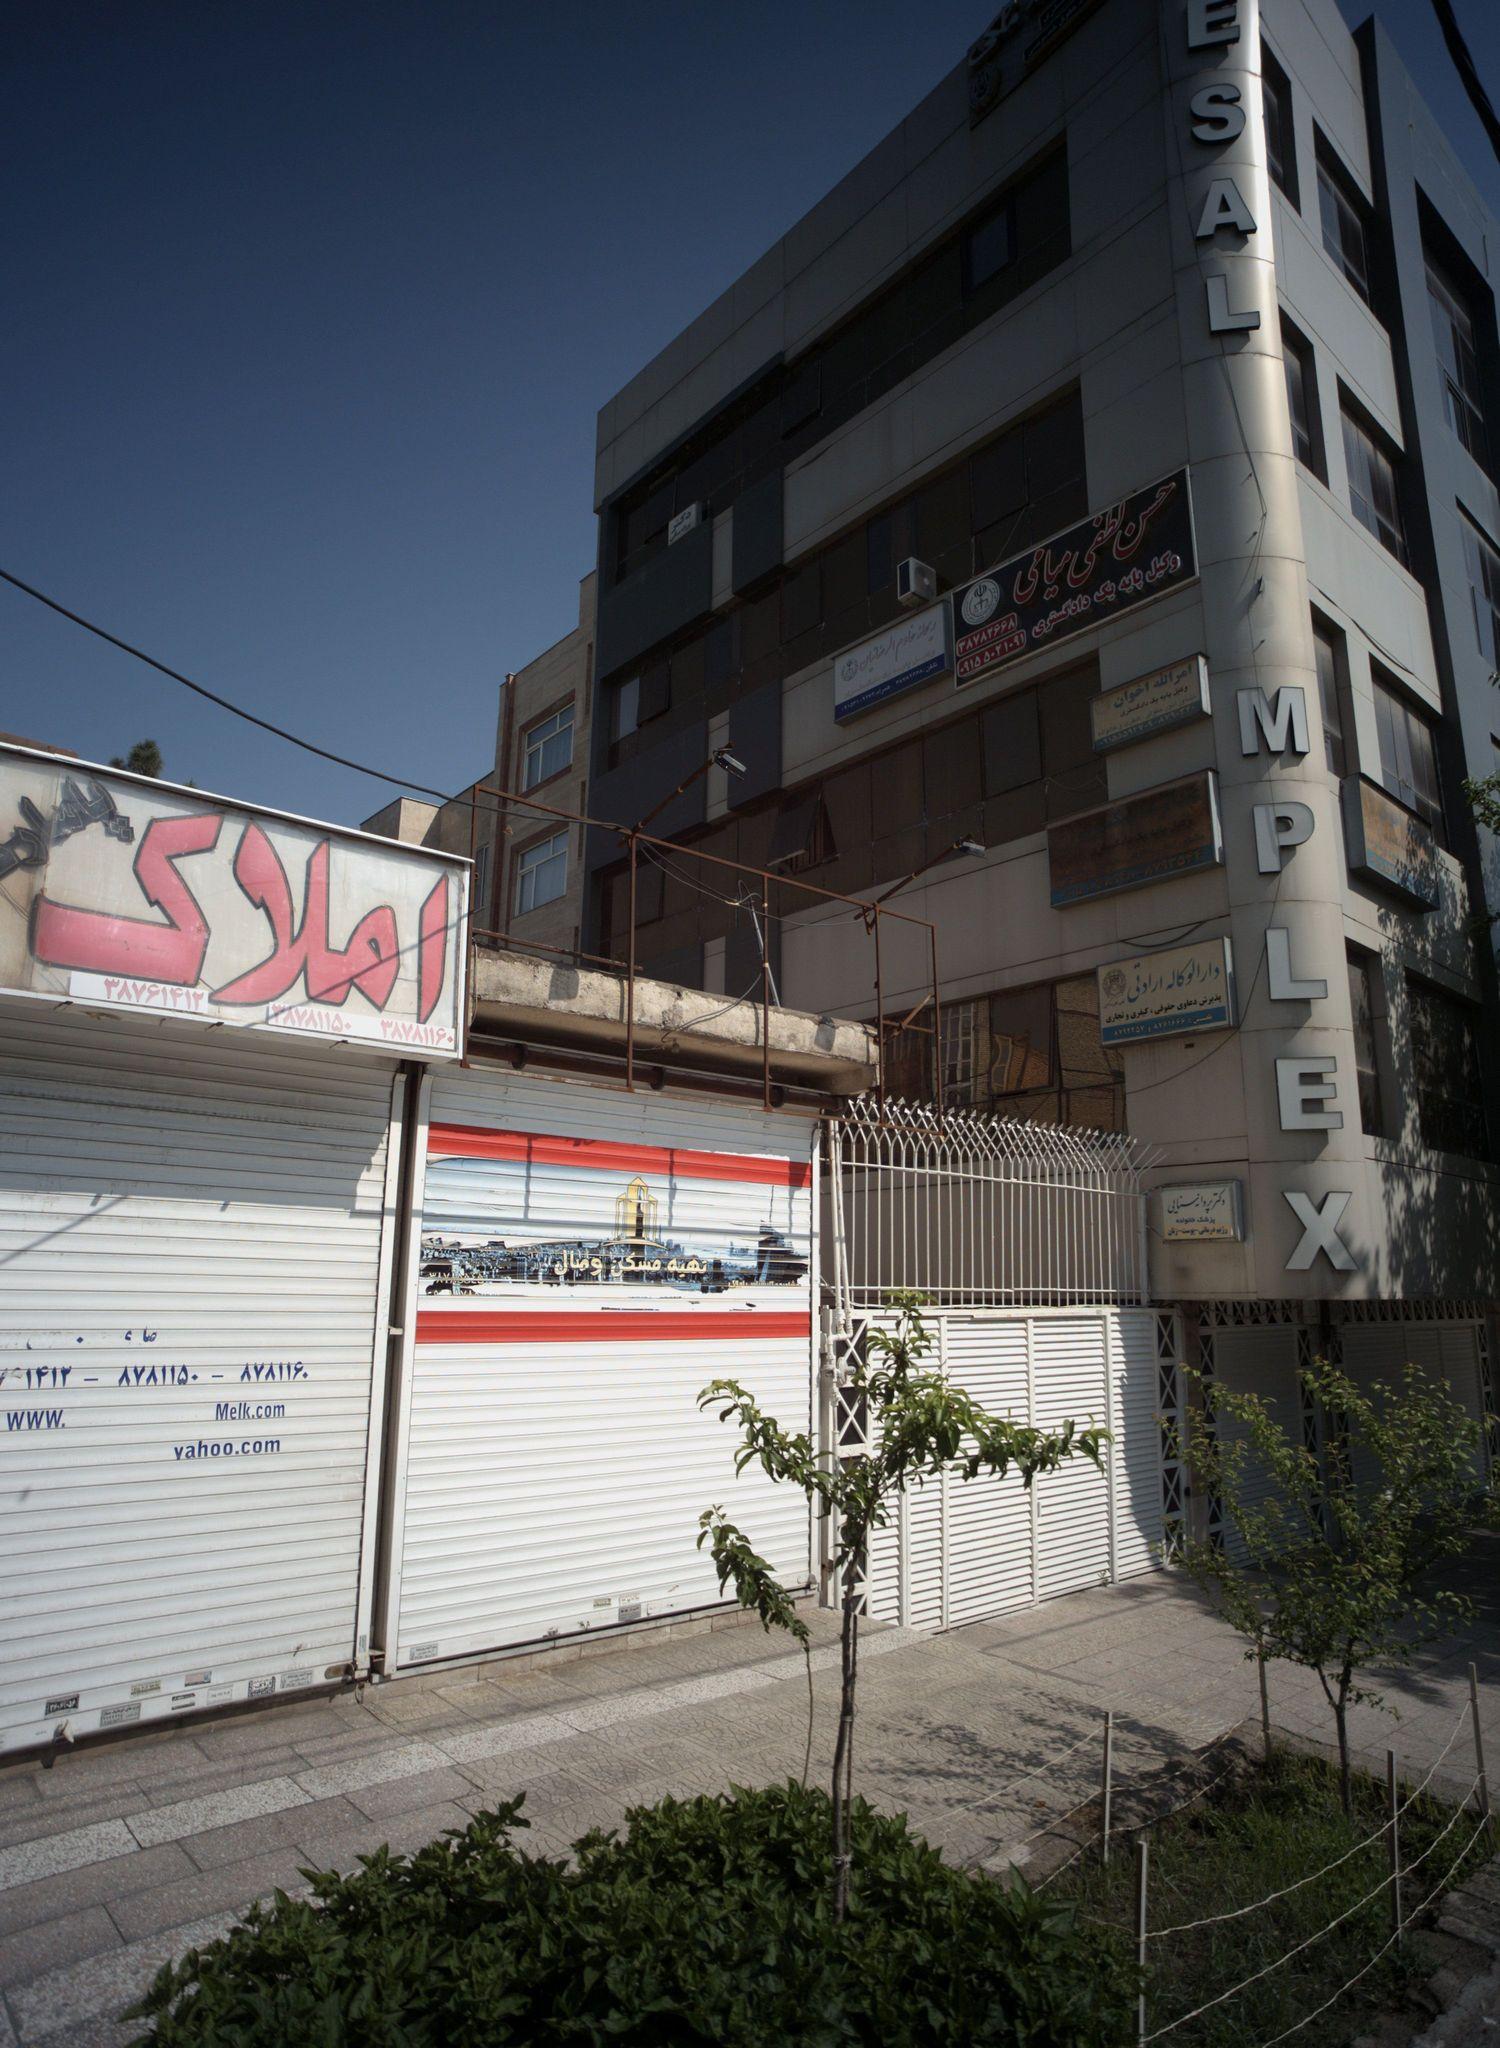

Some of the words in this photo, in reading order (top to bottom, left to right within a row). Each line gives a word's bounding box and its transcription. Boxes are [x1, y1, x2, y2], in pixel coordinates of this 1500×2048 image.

[1145, 550, 1181, 583] وکیل
[1094, 580, 1116, 603] یک
[1119, 567, 1143, 593] پایه
[1032, 594, 1091, 639] دادگستری
[32, 813, 449, 1024] املاک
[1211, 1188, 1226, 1211] دکتر
[610, 1252, 663, 1278] مسکن
[667, 1256, 708, 1279] تهیه
[118, 1365, 199, 1387] ۸۷۸۱۱۵۰
[240, 1361, 309, 1383] ۸۷۸۱۱۶۰
[215, 1402, 286, 1421] Melk.com
[174, 1439, 281, 1460] yahoo.com
